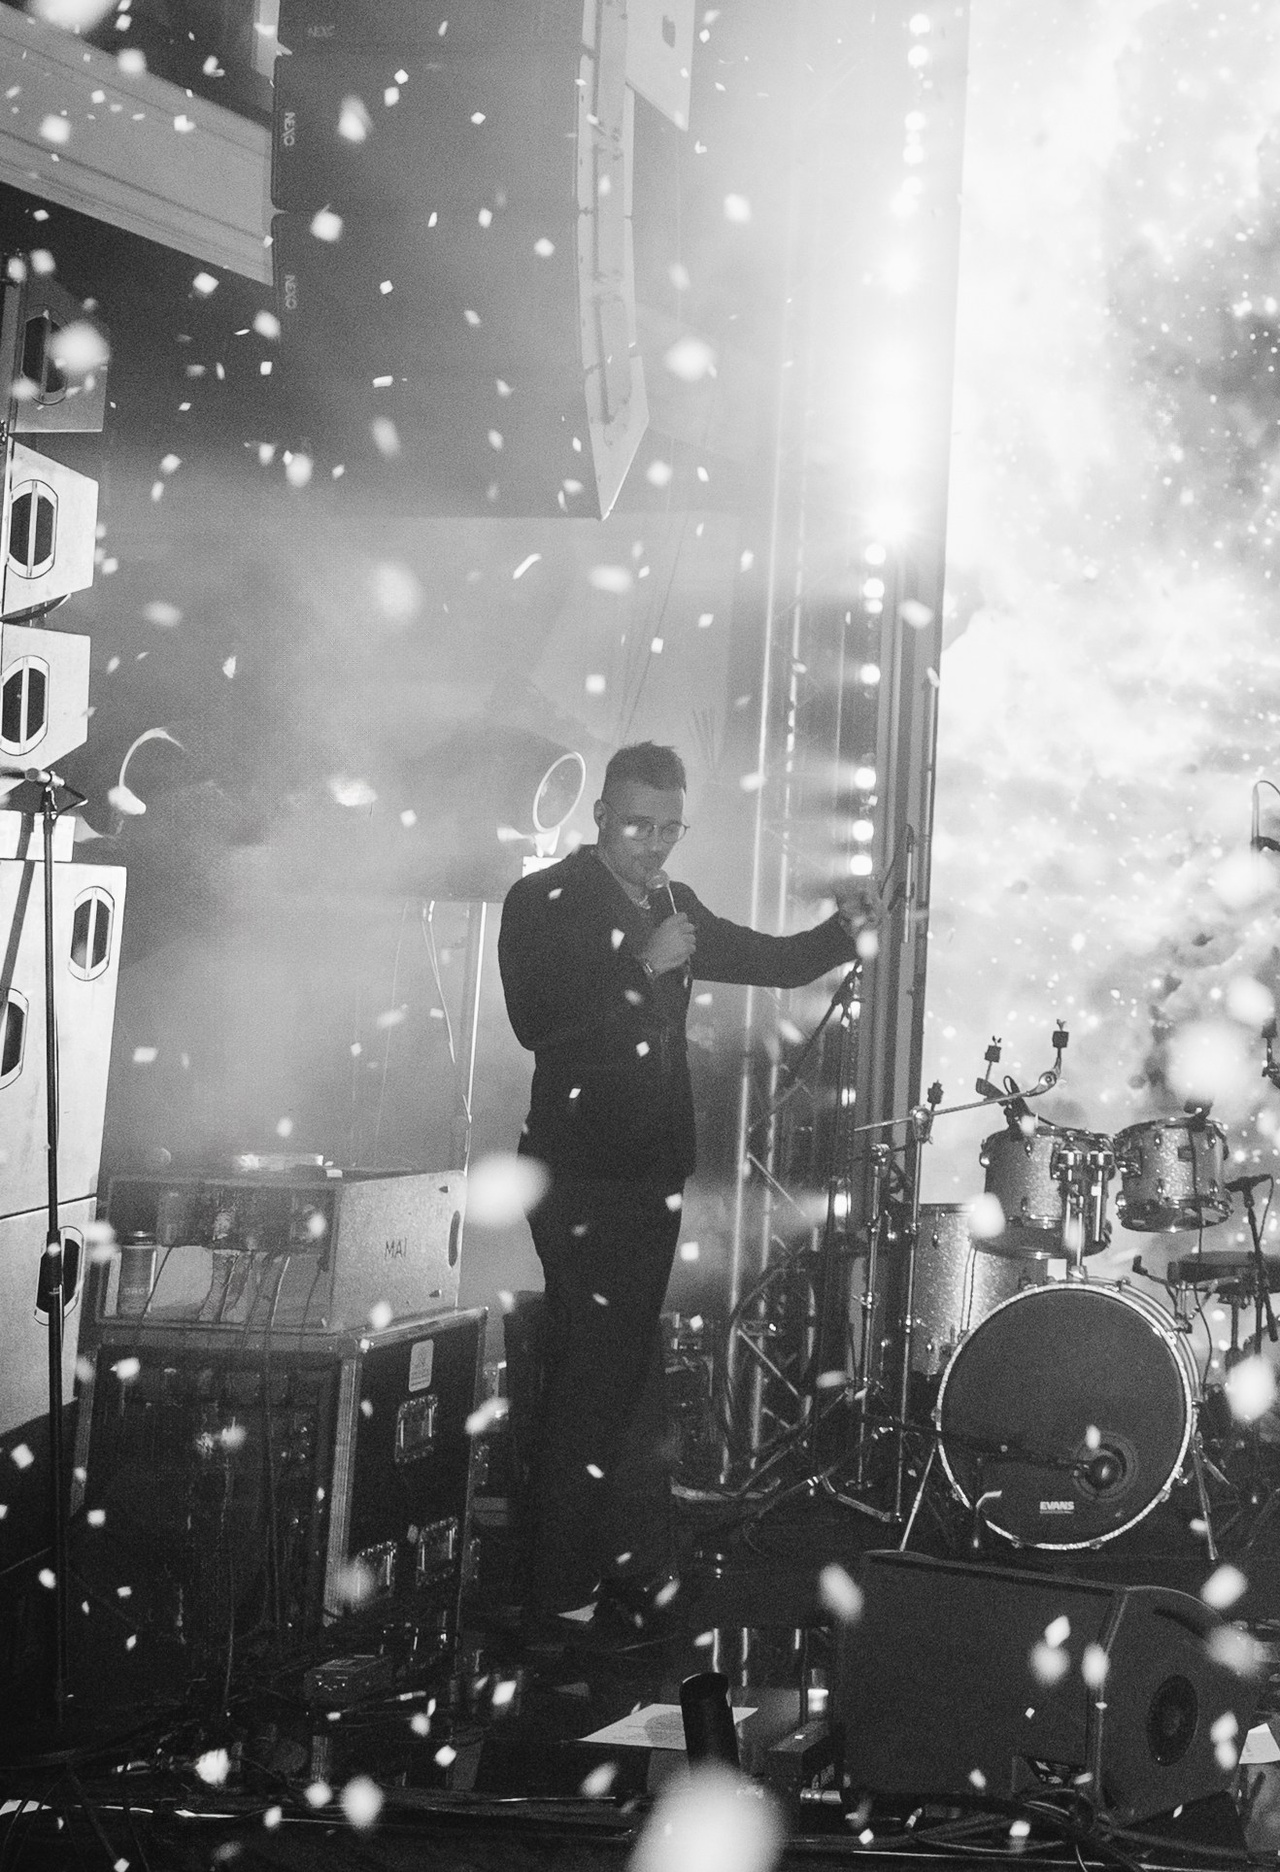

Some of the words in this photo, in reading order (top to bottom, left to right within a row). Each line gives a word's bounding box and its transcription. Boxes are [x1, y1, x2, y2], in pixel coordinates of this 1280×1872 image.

[284, 112, 295, 146] NEXO
[284, 275, 297, 309] NEXO
[1039, 1500, 1074, 1510] EVANS
